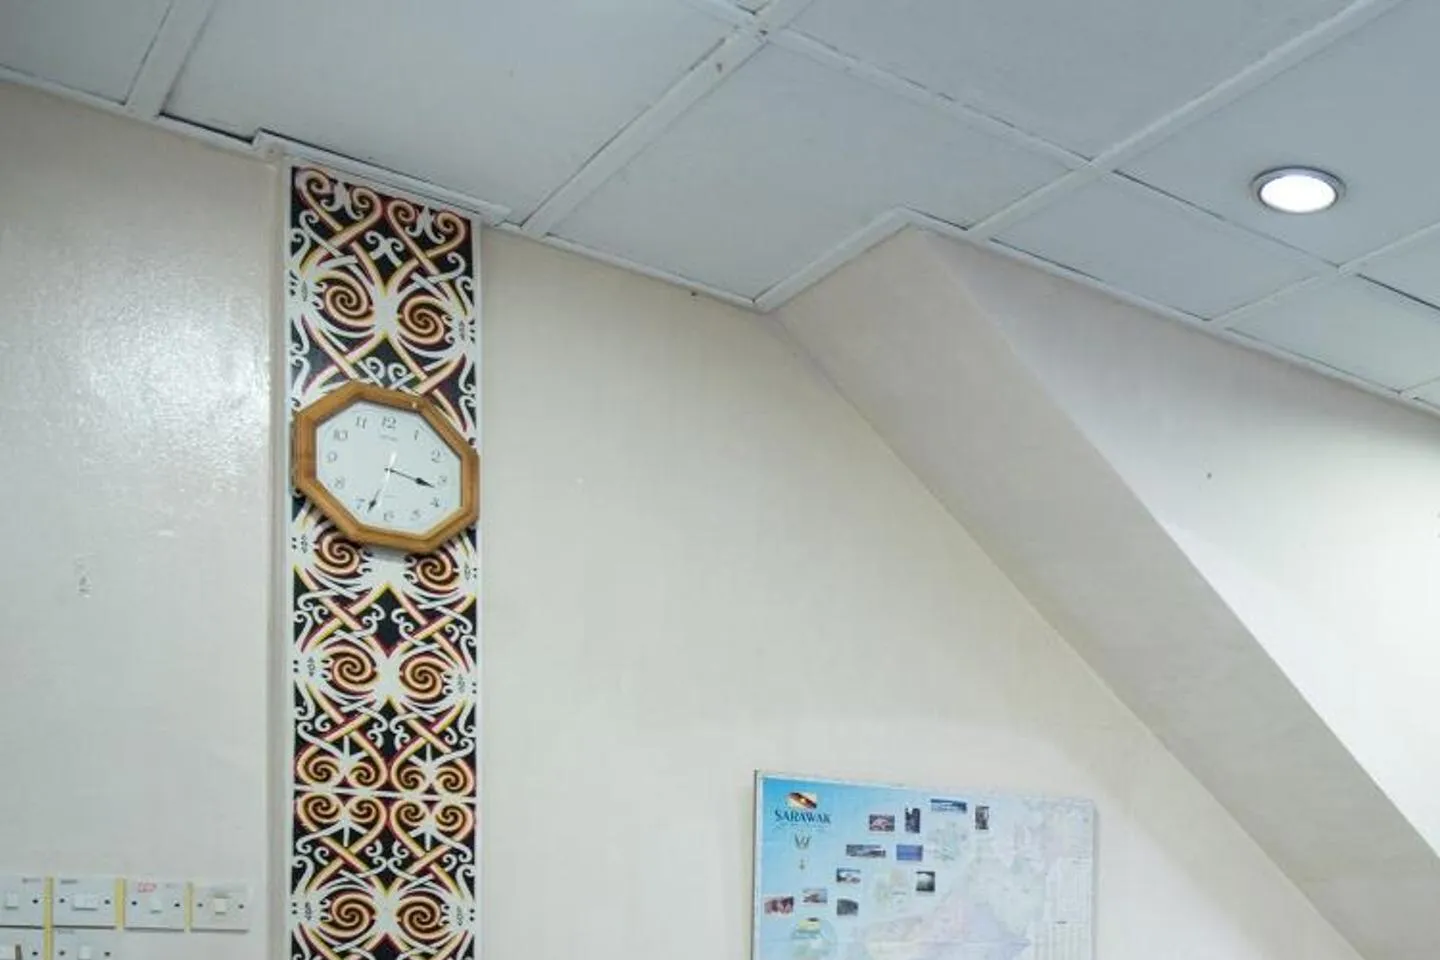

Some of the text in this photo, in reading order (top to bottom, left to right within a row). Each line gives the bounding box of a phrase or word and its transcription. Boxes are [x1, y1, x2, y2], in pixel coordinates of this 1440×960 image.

[355, 415, 368, 430] 11
[382, 415, 398, 430] 12
[332, 429, 349, 441] 10
[413, 429, 420, 441] 1
[326, 450, 338, 463] 9
[430, 448, 442, 463] 2
[774, 809, 832, 824] SARAWAK
